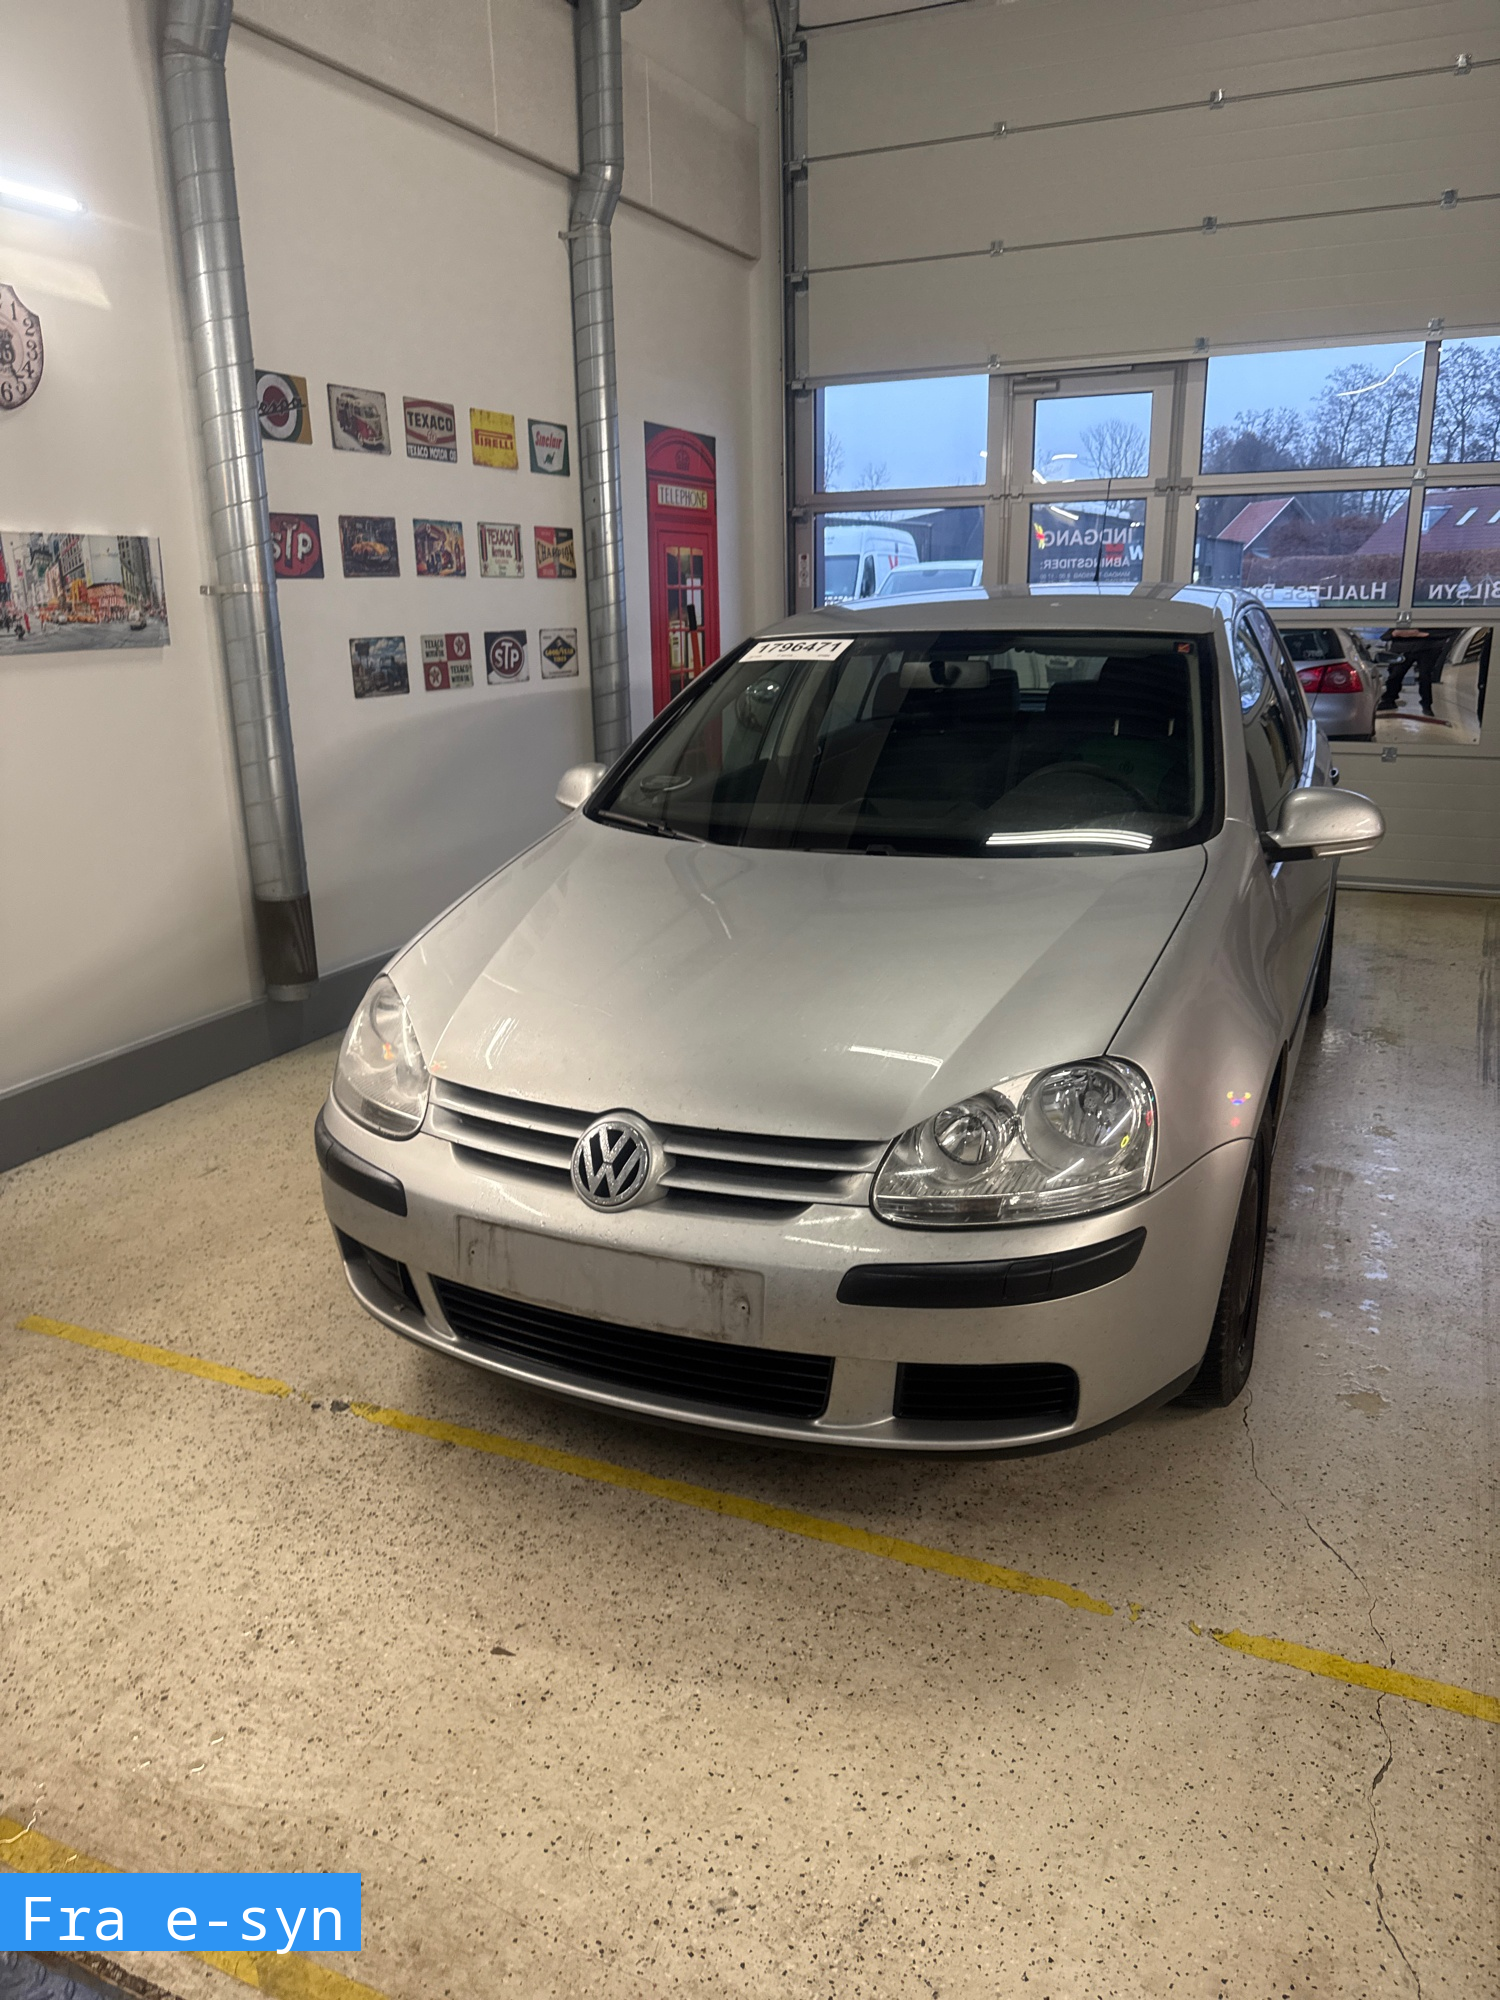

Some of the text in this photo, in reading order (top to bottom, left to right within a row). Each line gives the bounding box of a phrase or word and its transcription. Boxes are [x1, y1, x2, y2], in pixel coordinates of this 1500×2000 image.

[11, 301, 17, 320] 1
[23, 318, 35, 336] 2
[26, 340, 38, 361] 3
[21, 360, 34, 379] 4
[1, 381, 13, 401] 6
[258, 397, 307, 417] espa
[406, 411, 453, 432] TEXACO
[474, 428, 513, 450] PIRELLI
[535, 430, 563, 449] Sinclair
[407, 444, 429, 458] TEXACO
[429, 447, 448, 460] MOTOR
[660, 486, 706, 507] TELEPHONE
[486, 528, 514, 547] TEXACO
[537, 539, 574, 565] CHAMPION
[424, 638, 444, 649] TEXACO
[758, 641, 843, 654] 1796471
[494, 641, 520, 670] STP
[450, 664, 469, 674] TEXACO
[576, 1122, 646, 1205] VW
